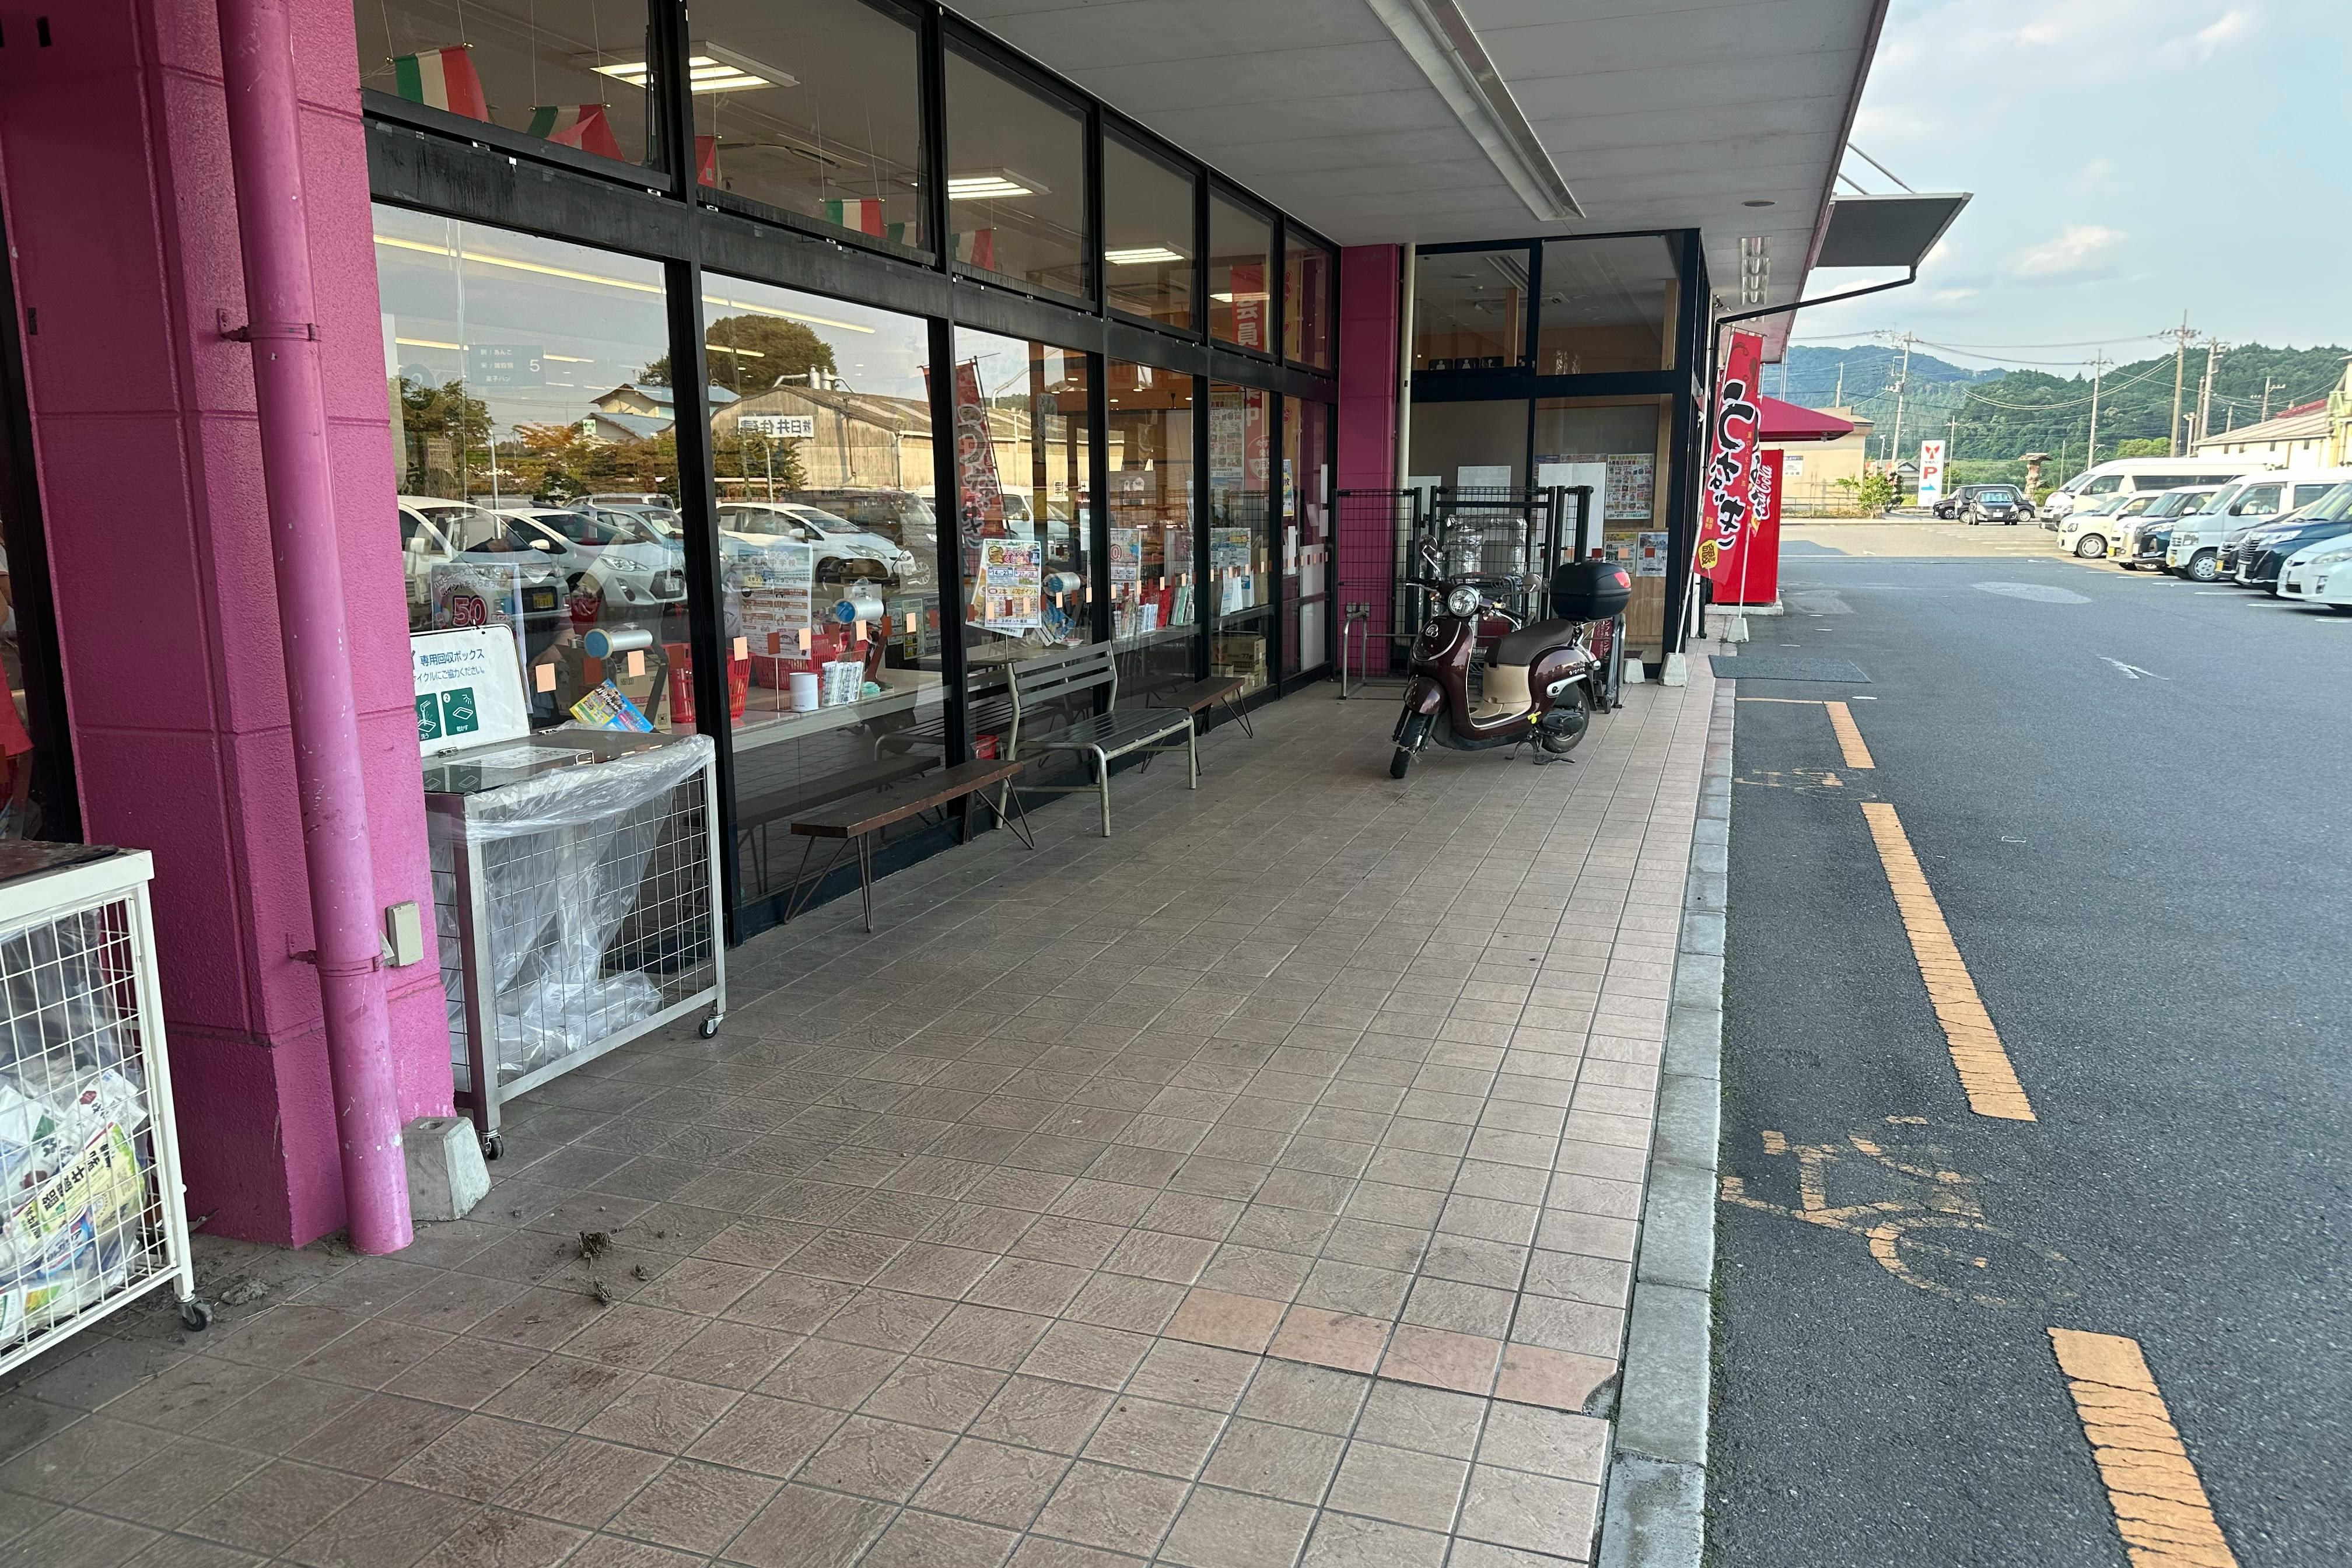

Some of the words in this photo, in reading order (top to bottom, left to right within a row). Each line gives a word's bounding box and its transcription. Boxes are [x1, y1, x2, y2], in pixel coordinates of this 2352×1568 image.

[529, 359, 540, 372] 5
[710, 378, 719, 390] 6
[1923, 467, 1938, 479] P
[452, 595, 488, 627] 50
[419, 648, 485, 667] 専用回収ボックス
